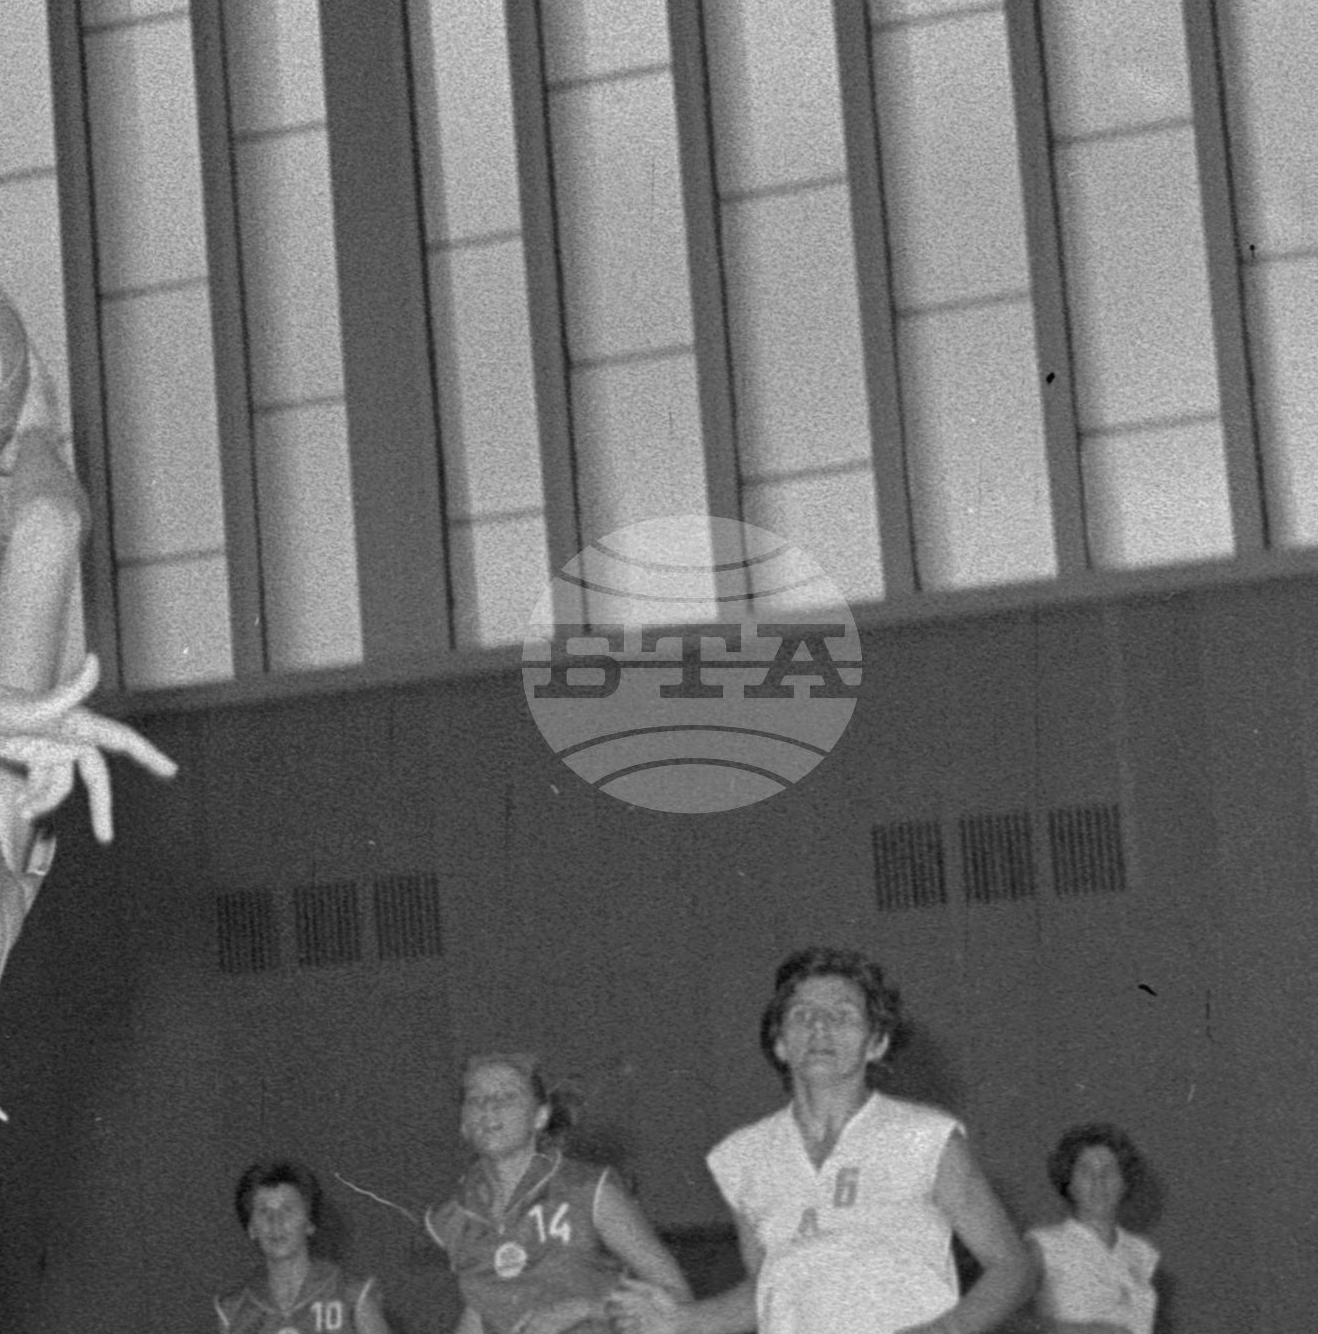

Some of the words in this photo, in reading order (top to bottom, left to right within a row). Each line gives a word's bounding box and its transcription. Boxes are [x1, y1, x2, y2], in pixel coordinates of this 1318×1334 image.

[833, 1166, 860, 1208] 6
[527, 1203, 571, 1244] 14
[310, 1300, 343, 1333] 10
